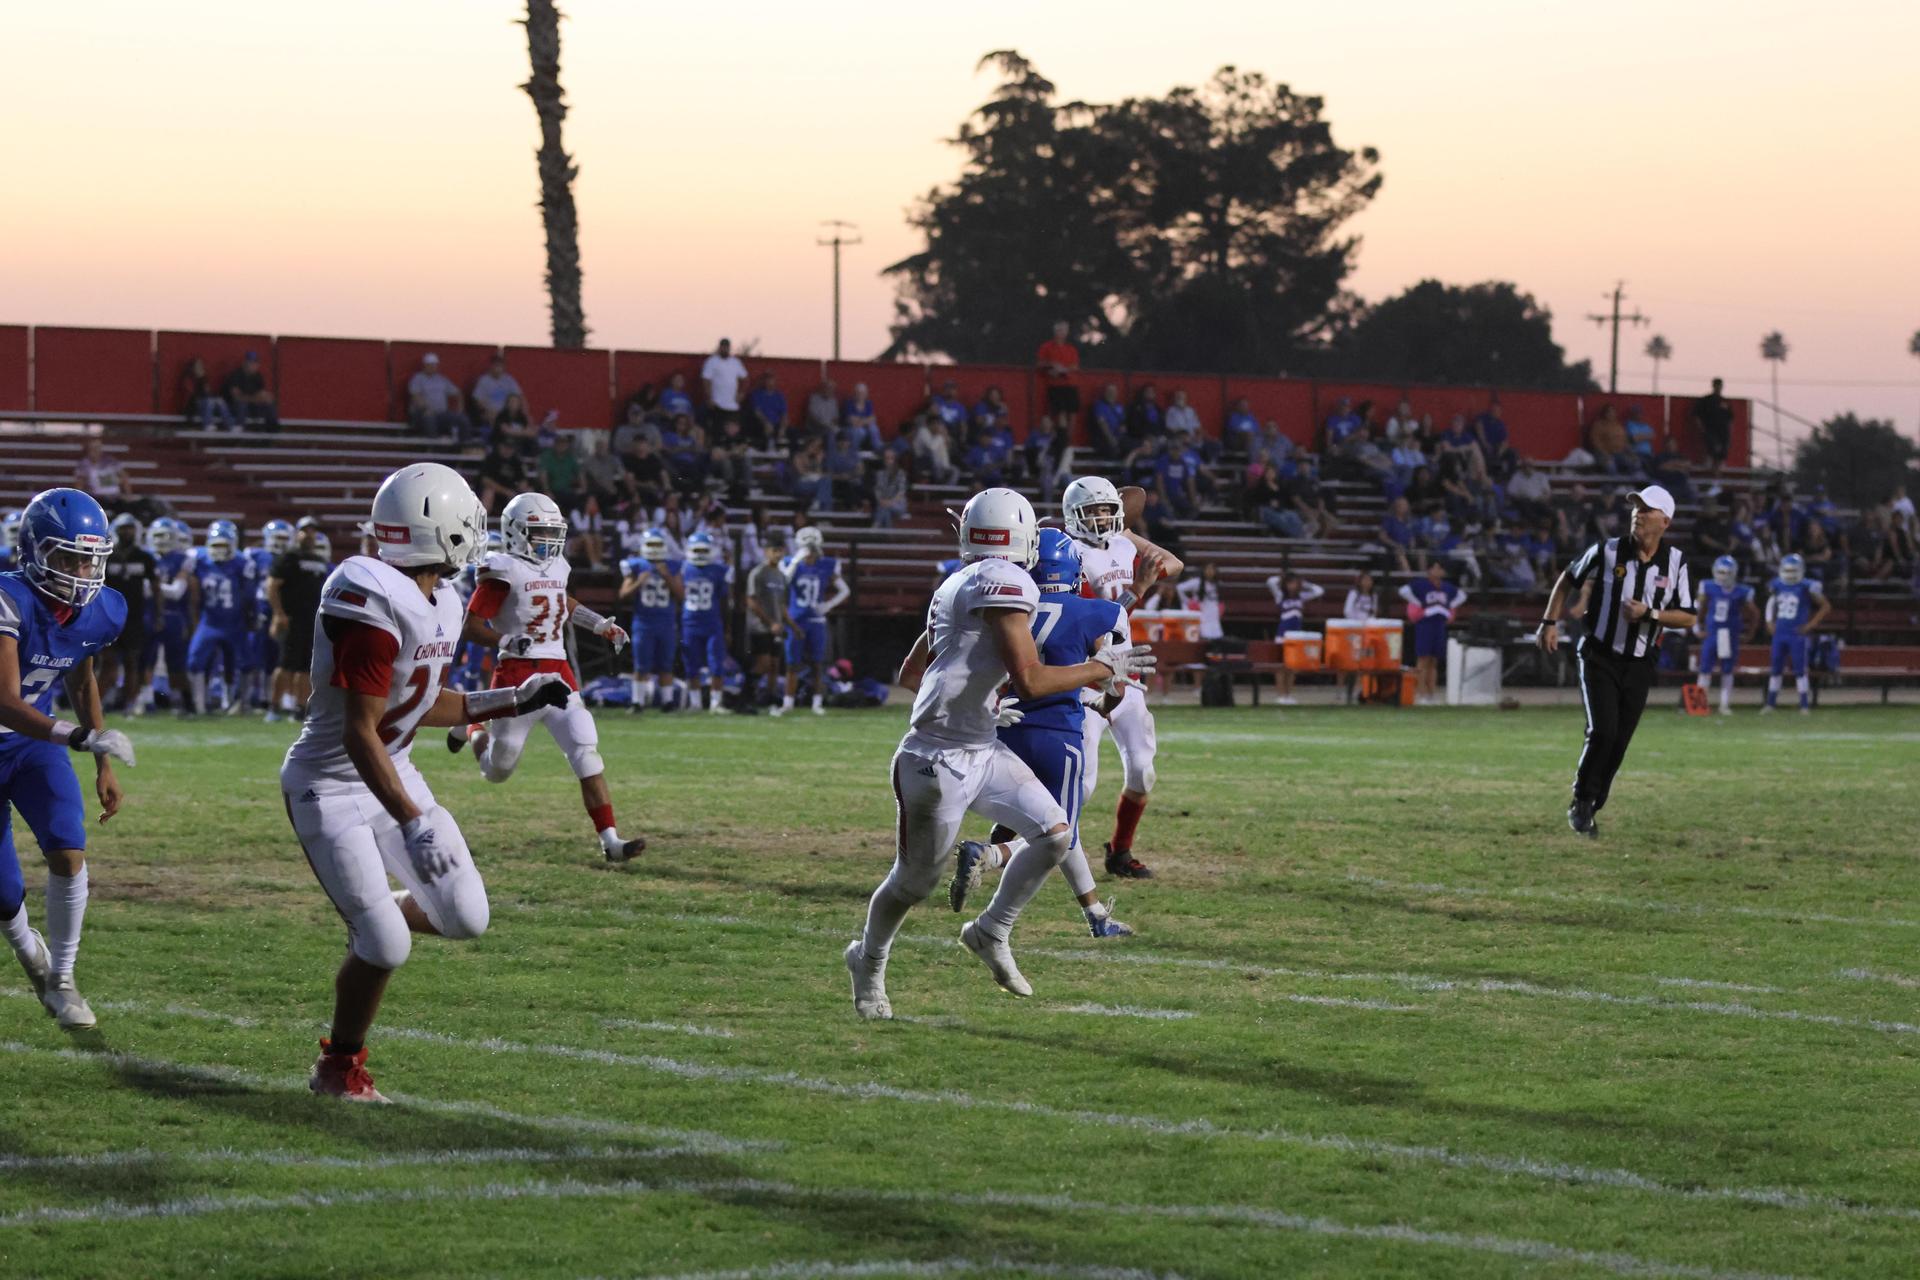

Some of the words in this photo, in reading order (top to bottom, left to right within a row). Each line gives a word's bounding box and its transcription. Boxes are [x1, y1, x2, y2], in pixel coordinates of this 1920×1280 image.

[986, 533, 1006, 541] TRIBE
[524, 580, 565, 592] CHOWCHILL
[796, 577, 820, 608] 31
[1040, 585, 1060, 593] dell
[526, 592, 565, 644] 21
[413, 641, 456, 661] CHOWCHILL
